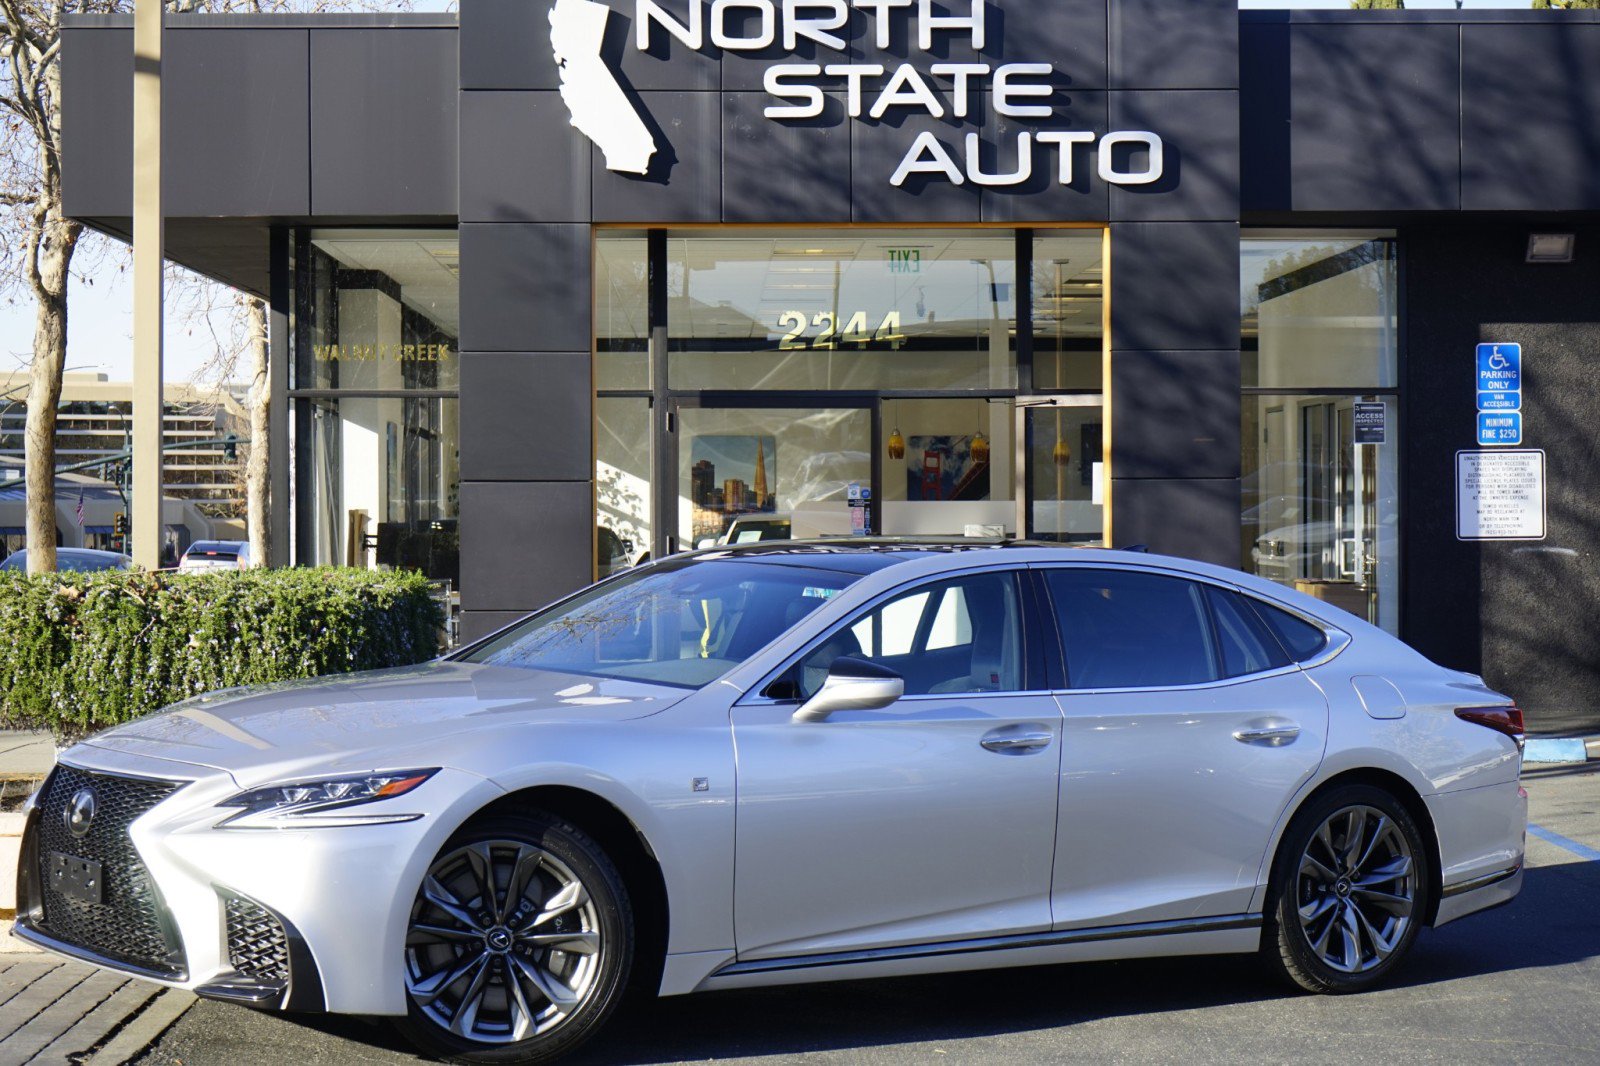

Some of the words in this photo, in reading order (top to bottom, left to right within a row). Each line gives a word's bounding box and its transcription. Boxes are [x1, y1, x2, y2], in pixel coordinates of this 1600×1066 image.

[636, 0, 985, 51] NORTH
[763, 63, 1053, 118] STATE
[890, 131, 1163, 186] AUTO
[777, 310, 904, 350] 2244
[313, 344, 388, 360] WALNUT
[392, 344, 449, 360] CREEK
[1480, 370, 1517, 379] PARKING
[1487, 380, 1510, 389] ONLY
[1485, 418, 1513, 427] MINIMUM
[1482, 429, 1496, 439] FINE
[1499, 429, 1517, 439] $250
